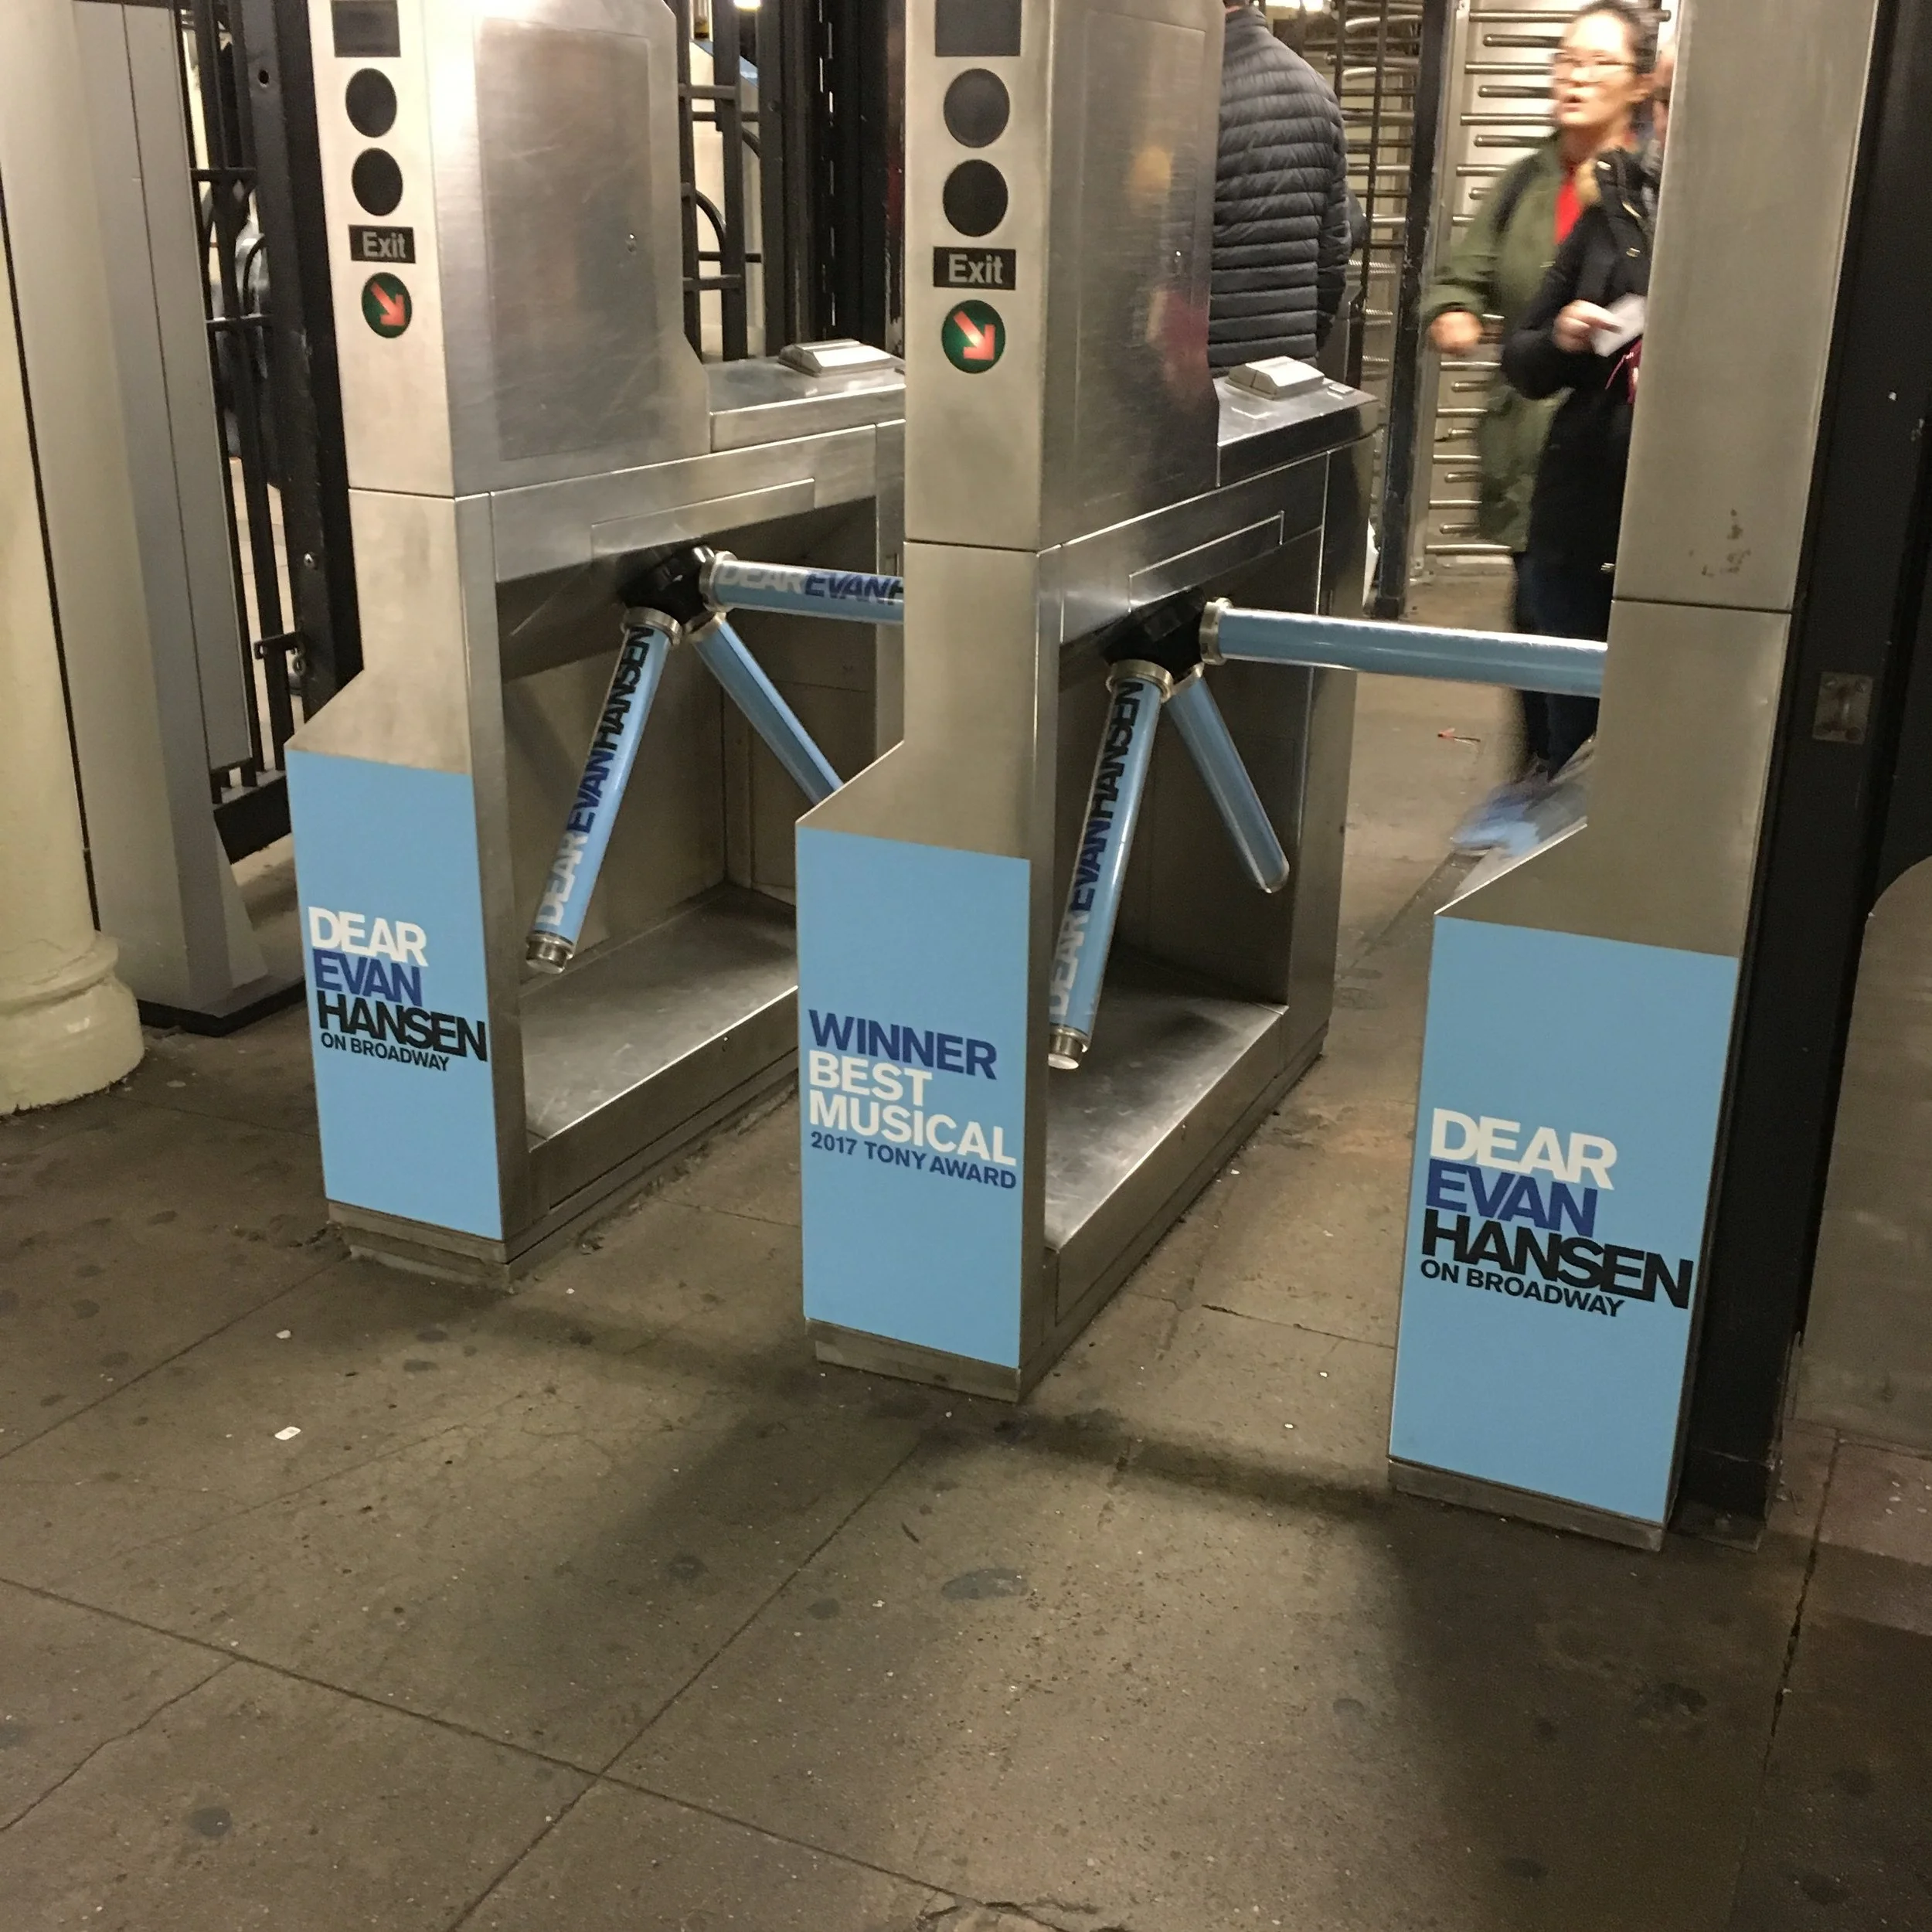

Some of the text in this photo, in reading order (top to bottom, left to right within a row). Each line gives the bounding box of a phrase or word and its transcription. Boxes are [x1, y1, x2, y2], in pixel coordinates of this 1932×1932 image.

[362, 231, 406, 258] Exit
[948, 253, 1003, 284] Exit
[804, 573, 895, 606] EVAN
[566, 750, 615, 834] EVAN
[1070, 819, 1111, 912] EVAN
[308, 906, 428, 967] DEAR
[312, 948, 423, 1007] EVAN
[316, 990, 488, 1062] HANSEN
[321, 1032, 450, 1071] ON BROADWAY
[808, 1009, 998, 1080] WINNER
[809, 1049, 933, 1107] BEST
[809, 1089, 1017, 1166] MUSICAL
[1430, 1107, 1617, 1190] DEAR
[811, 1131, 1017, 1189] 2017 TONY AWARD
[1426, 1158, 1598, 1238] EVAN
[1420, 1259, 1625, 1317] ON BROADWAY
[1422, 1208, 1694, 1310] HANSEN
